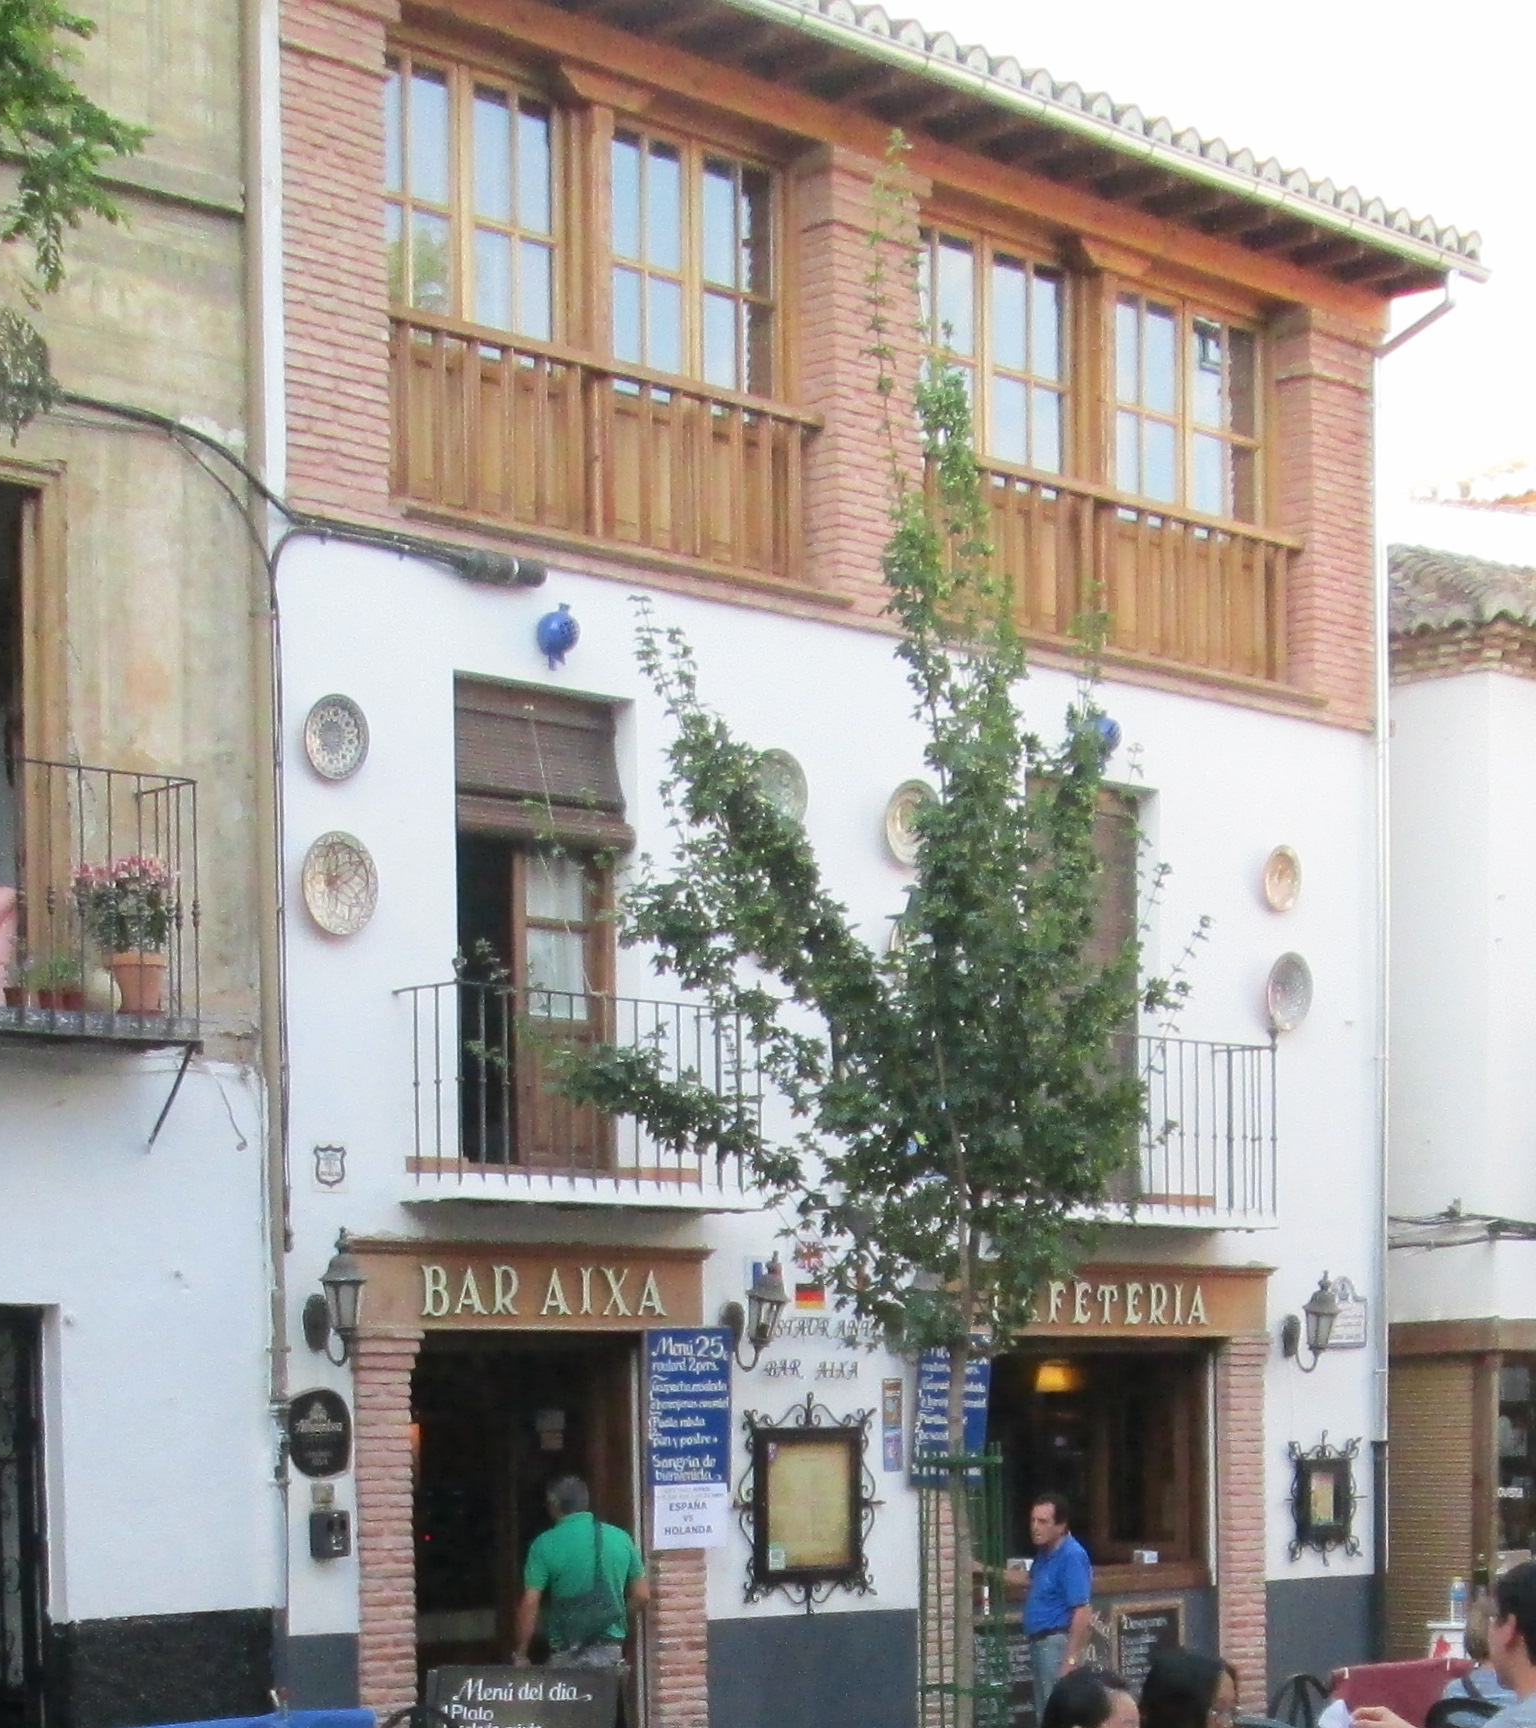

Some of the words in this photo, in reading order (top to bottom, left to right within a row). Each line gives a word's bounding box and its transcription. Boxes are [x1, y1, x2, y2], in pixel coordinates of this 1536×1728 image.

[421, 1265, 519, 1317] BAR
[540, 1267, 668, 1317] AIXA
[763, 1359, 804, 1379] BAR
[815, 1361, 858, 1380] AIXA
[669, 1500, 707, 1511] ESPAÑA
[664, 1525, 713, 1536] HOLANDA
[452, 1677, 515, 1701] Menú
[518, 1682, 544, 1701] del
